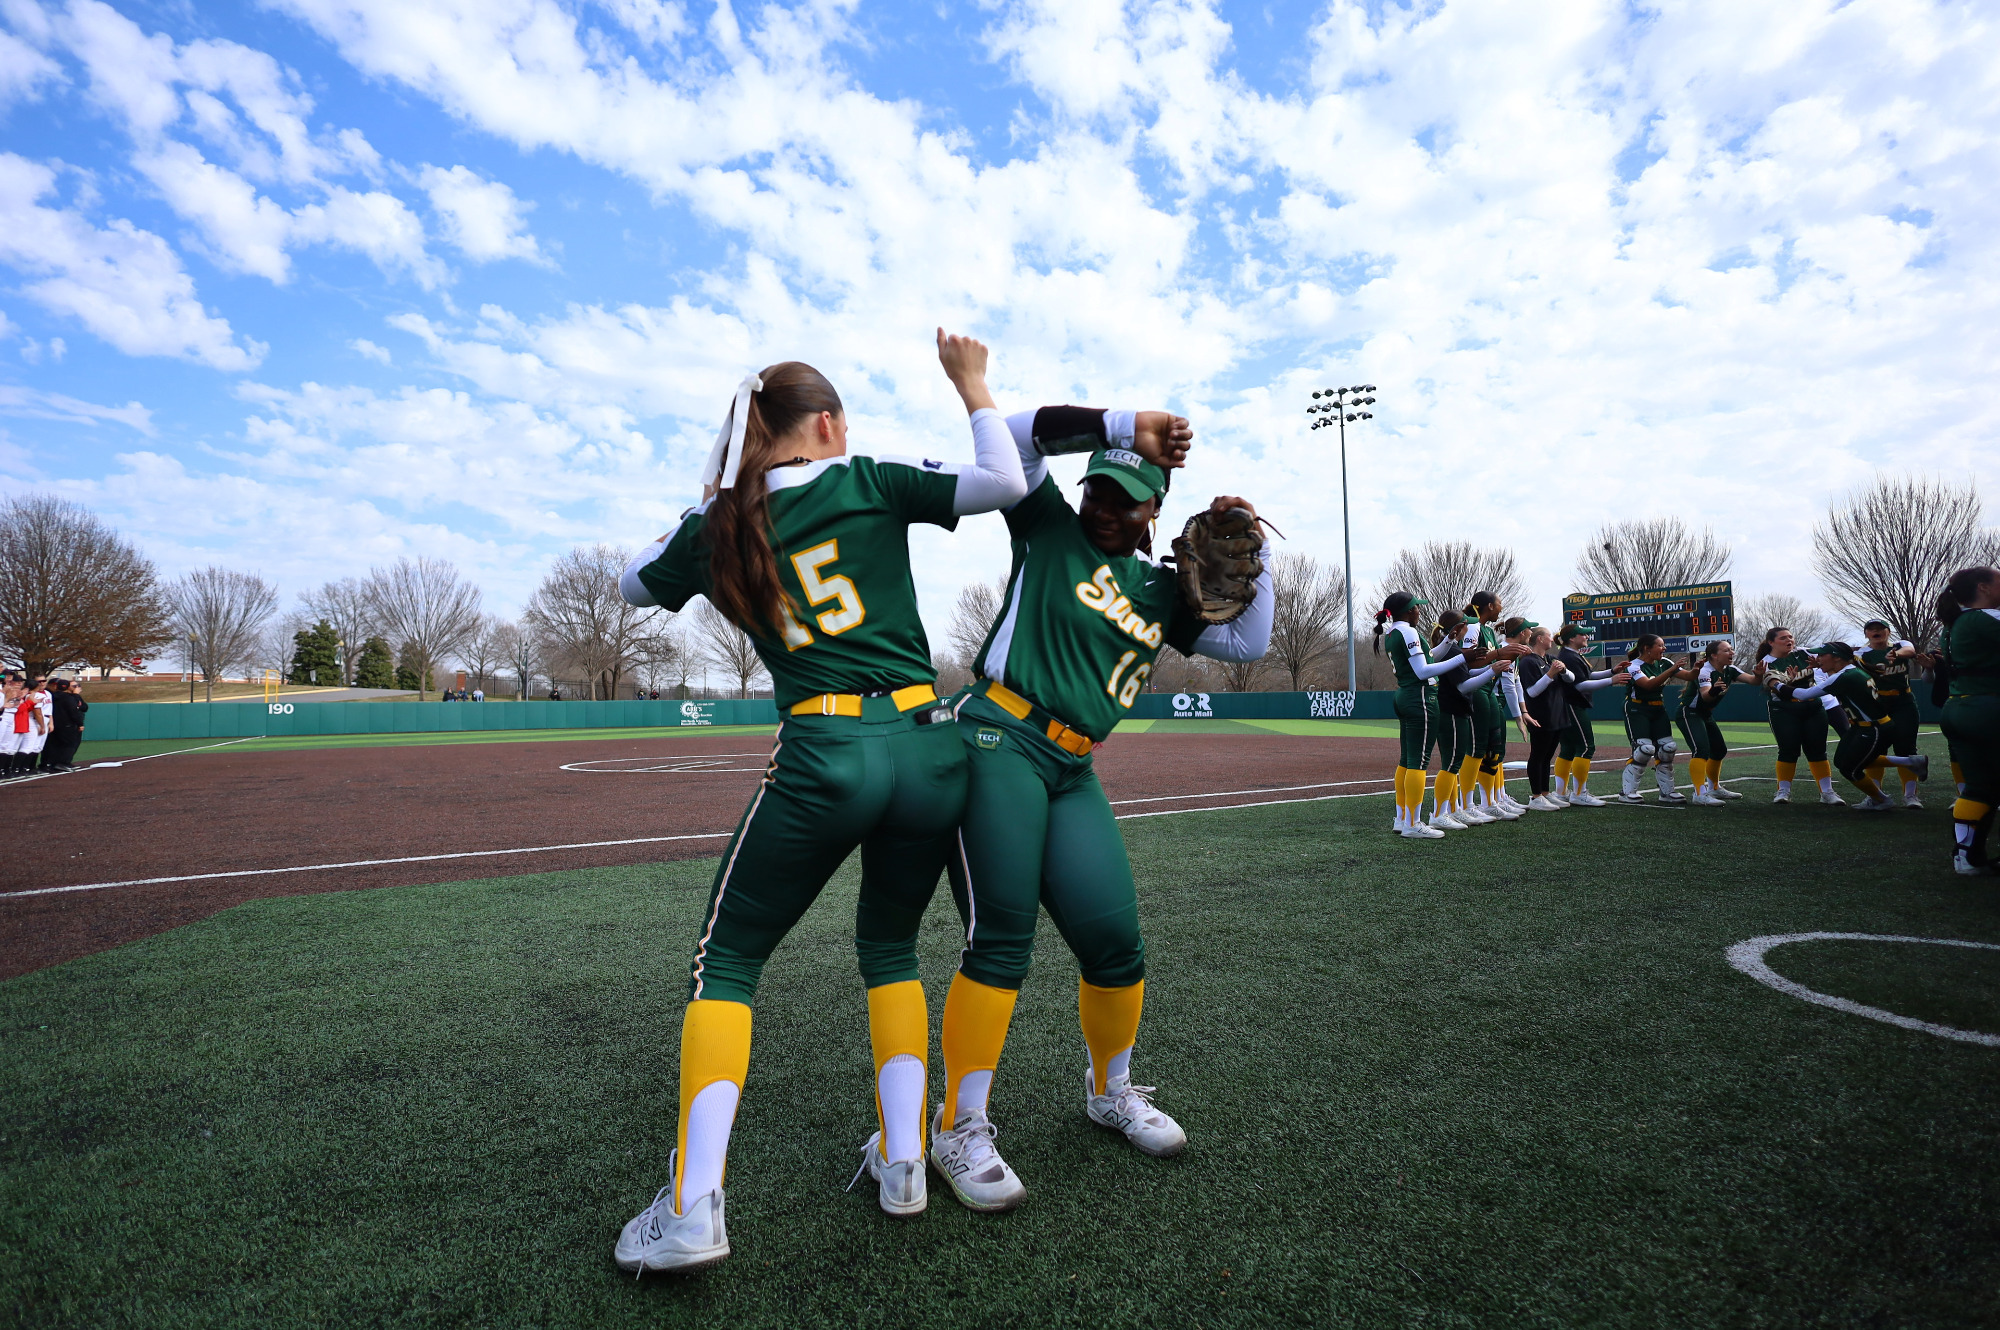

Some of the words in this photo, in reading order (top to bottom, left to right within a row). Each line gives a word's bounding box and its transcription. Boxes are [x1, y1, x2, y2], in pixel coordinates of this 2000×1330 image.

[1108, 450, 1139, 466] TECH
[1569, 595, 1588, 603] TECH
[1593, 593, 1641, 604] ARKANSAS
[1644, 590, 1667, 600] TECH
[1669, 585, 1727, 598] UNIVERSITY
[1076, 564, 1163, 649] Suns
[1595, 609, 1614, 617] BALL
[1627, 605, 1654, 615] STRIKE
[1667, 603, 1683, 611] OUT
[1571, 610, 1584, 620] 22
[1107, 650, 1151, 709] 16
[1307, 691, 1356, 700] VERLON
[268, 703, 294, 714] 190
[1310, 699, 1355, 709] ABRAM
[1310, 708, 1353, 717] FAMILY
[978, 733, 999, 742] TECH
